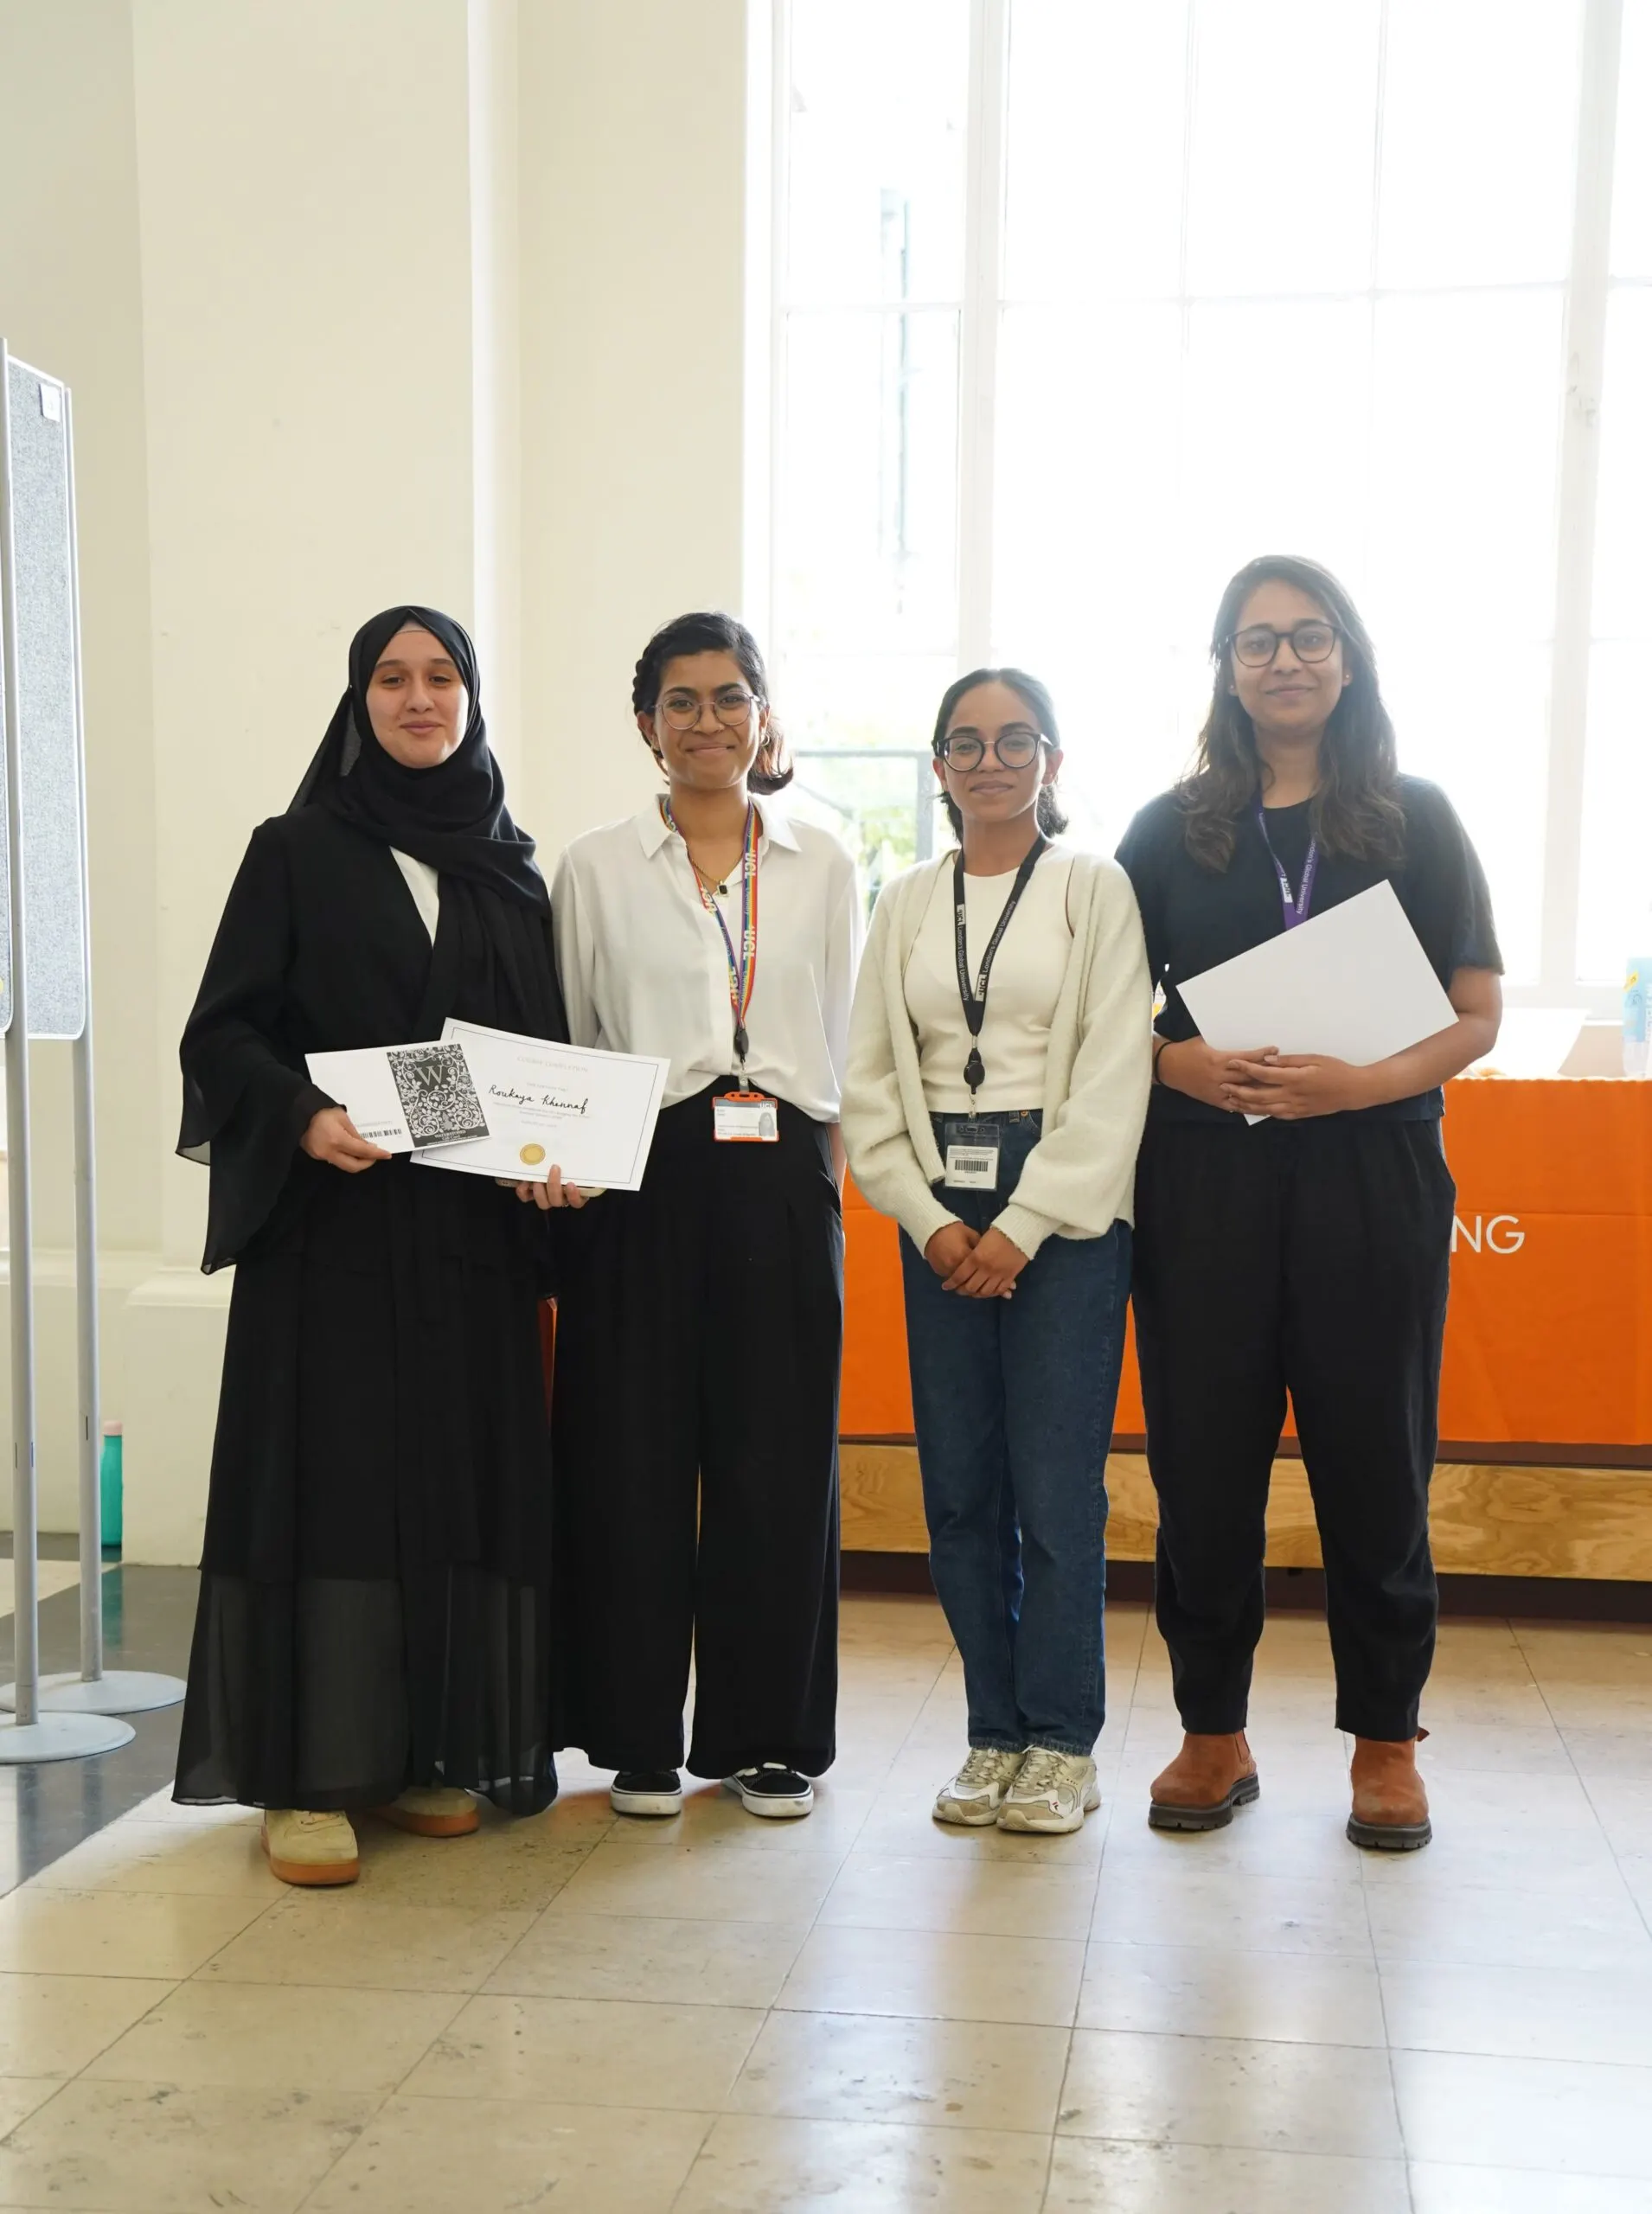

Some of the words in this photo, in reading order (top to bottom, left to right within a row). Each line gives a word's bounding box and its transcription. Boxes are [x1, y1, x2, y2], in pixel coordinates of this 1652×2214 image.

[745, 852, 757, 879] UCL
[1296, 884, 1309, 915] University
[744, 929, 756, 960] UCL
[978, 975, 987, 994] UCL
[983, 947, 995, 973] London's
[992, 927, 1003, 946] Global
[1001, 900, 1016, 928] University
[957, 950, 966, 969] Global
[959, 969, 970, 1001] University
[415, 1065, 443, 1086] W
[489, 1085, 535, 1105] Roukaya
